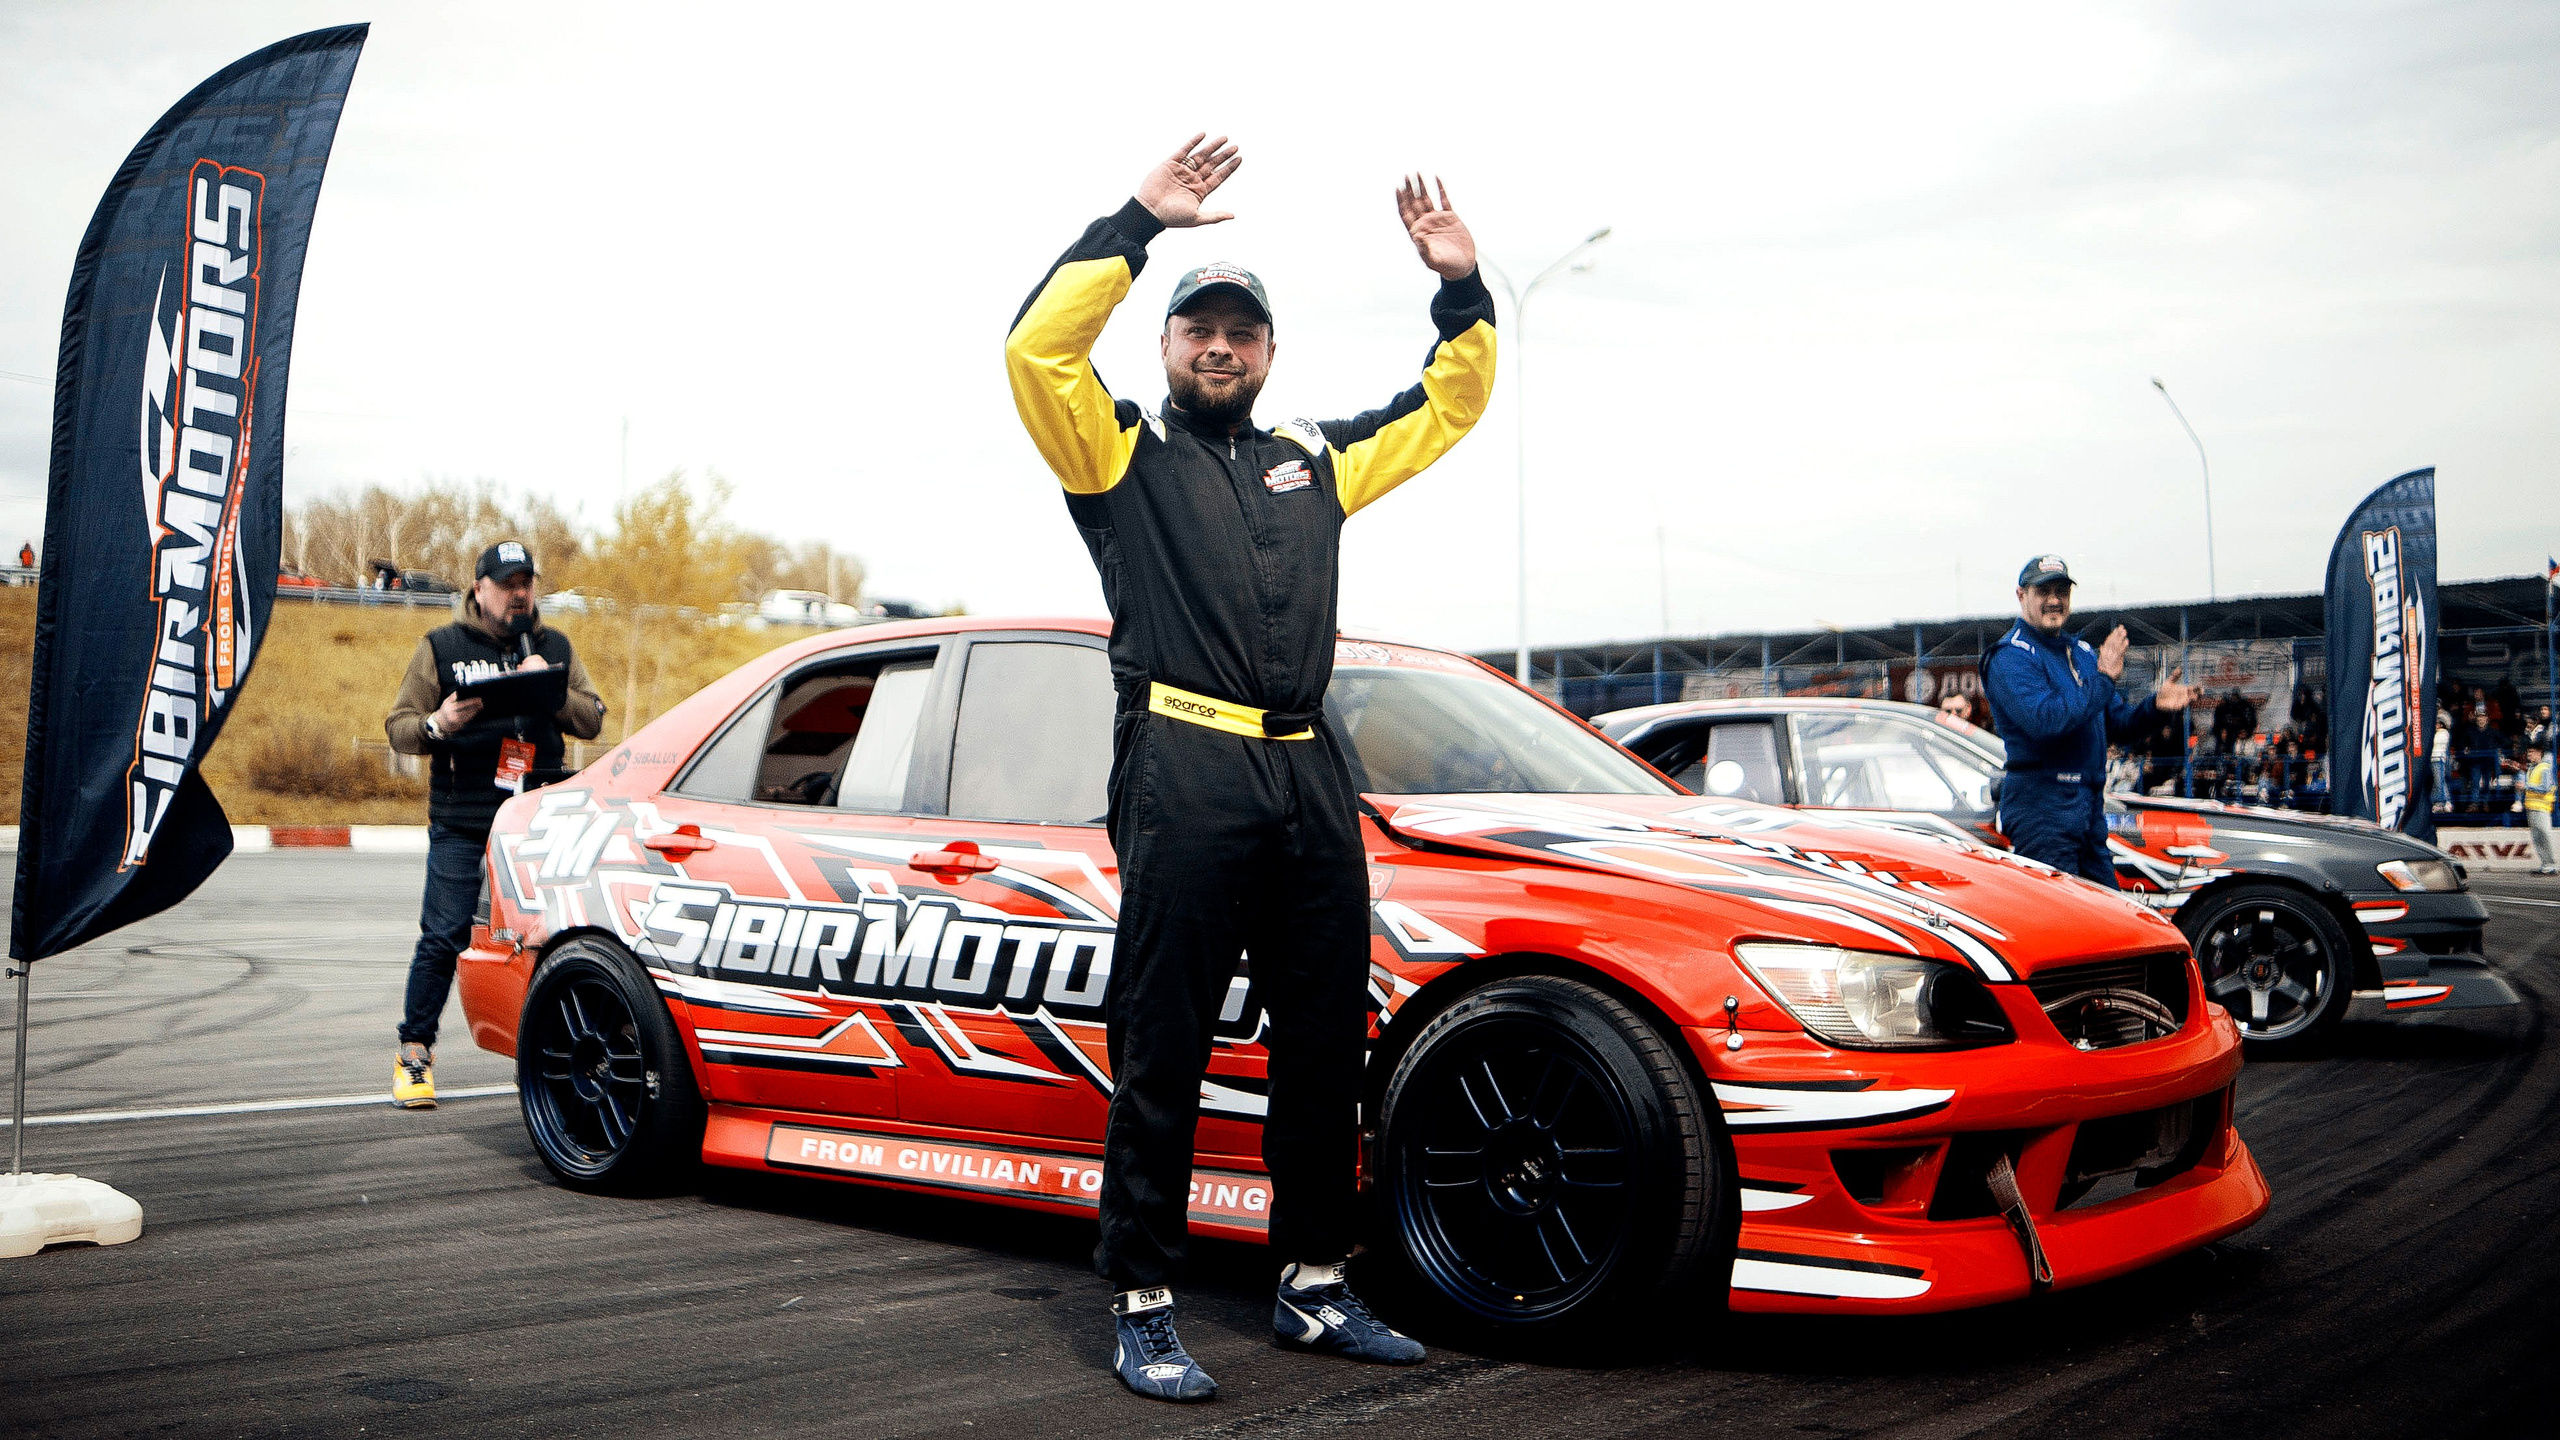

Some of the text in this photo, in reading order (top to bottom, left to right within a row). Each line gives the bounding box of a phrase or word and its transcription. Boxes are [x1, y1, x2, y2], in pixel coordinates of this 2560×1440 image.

[219, 606, 231, 667] FROM
[1164, 695, 1217, 717] sparco
[800, 1137, 884, 1167] FROM
[898, 1148, 1041, 1185] CIVILIAN
[1058, 1166, 1103, 1192] TO
[1138, 1290, 1165, 1304] OMP
[1318, 1307, 1346, 1326] OMP
[1146, 1366, 1185, 1378] OMP
